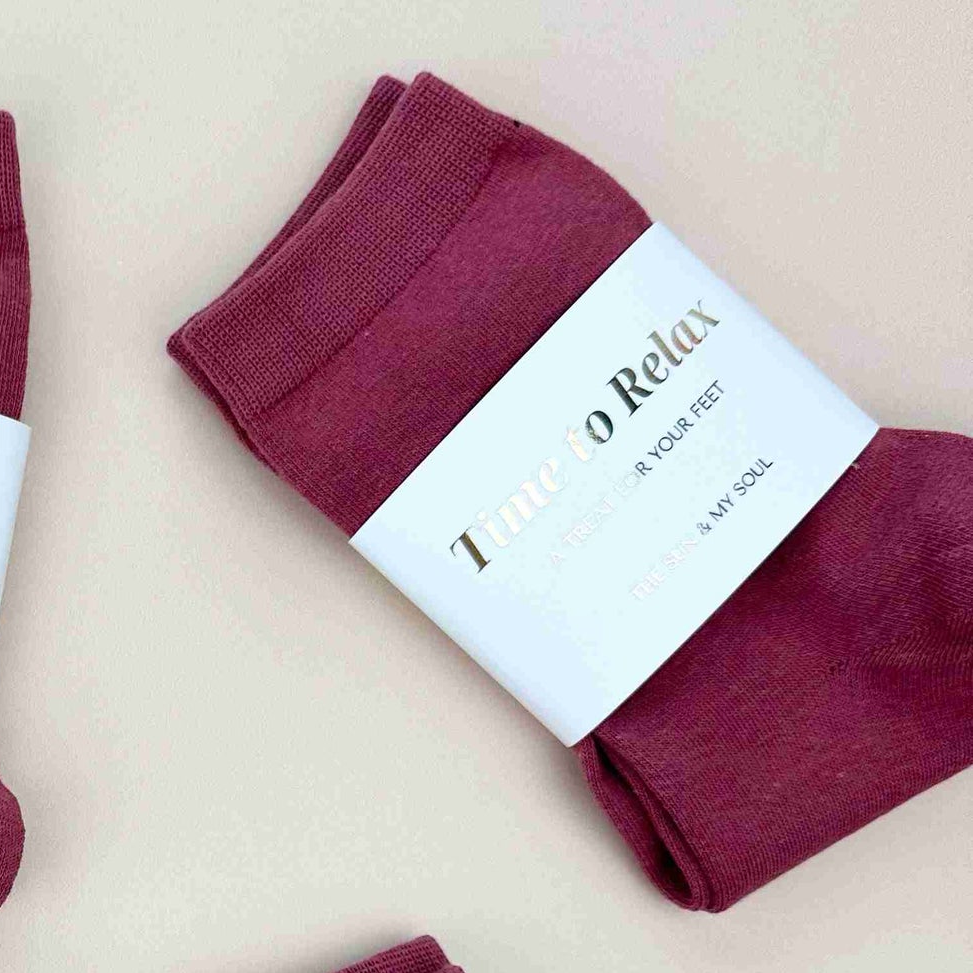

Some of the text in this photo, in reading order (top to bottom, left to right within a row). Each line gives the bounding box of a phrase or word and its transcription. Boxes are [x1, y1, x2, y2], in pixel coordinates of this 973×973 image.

[450, 299, 719, 574] Time to Relax
[550, 549, 564, 568] A
[647, 417, 695, 462] YOUR
[689, 380, 725, 418] FEET
[695, 519, 713, 535] &
[709, 492, 733, 523] MY
[732, 456, 773, 496] SOUL
